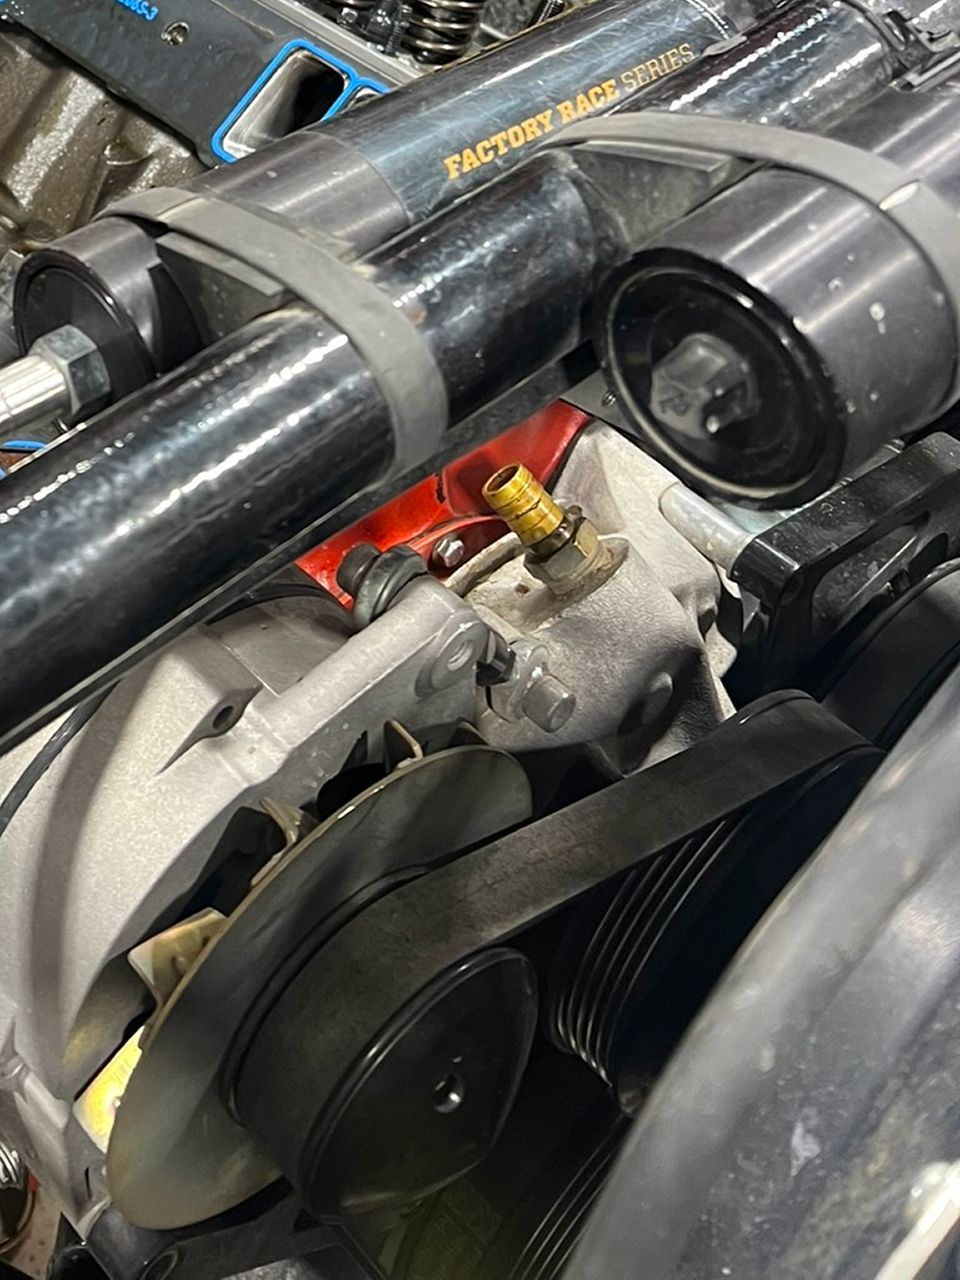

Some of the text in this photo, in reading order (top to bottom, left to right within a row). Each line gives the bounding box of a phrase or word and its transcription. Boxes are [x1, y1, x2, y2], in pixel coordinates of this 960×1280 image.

[443, 42, 695, 180] FACTORY RACE SERIES
